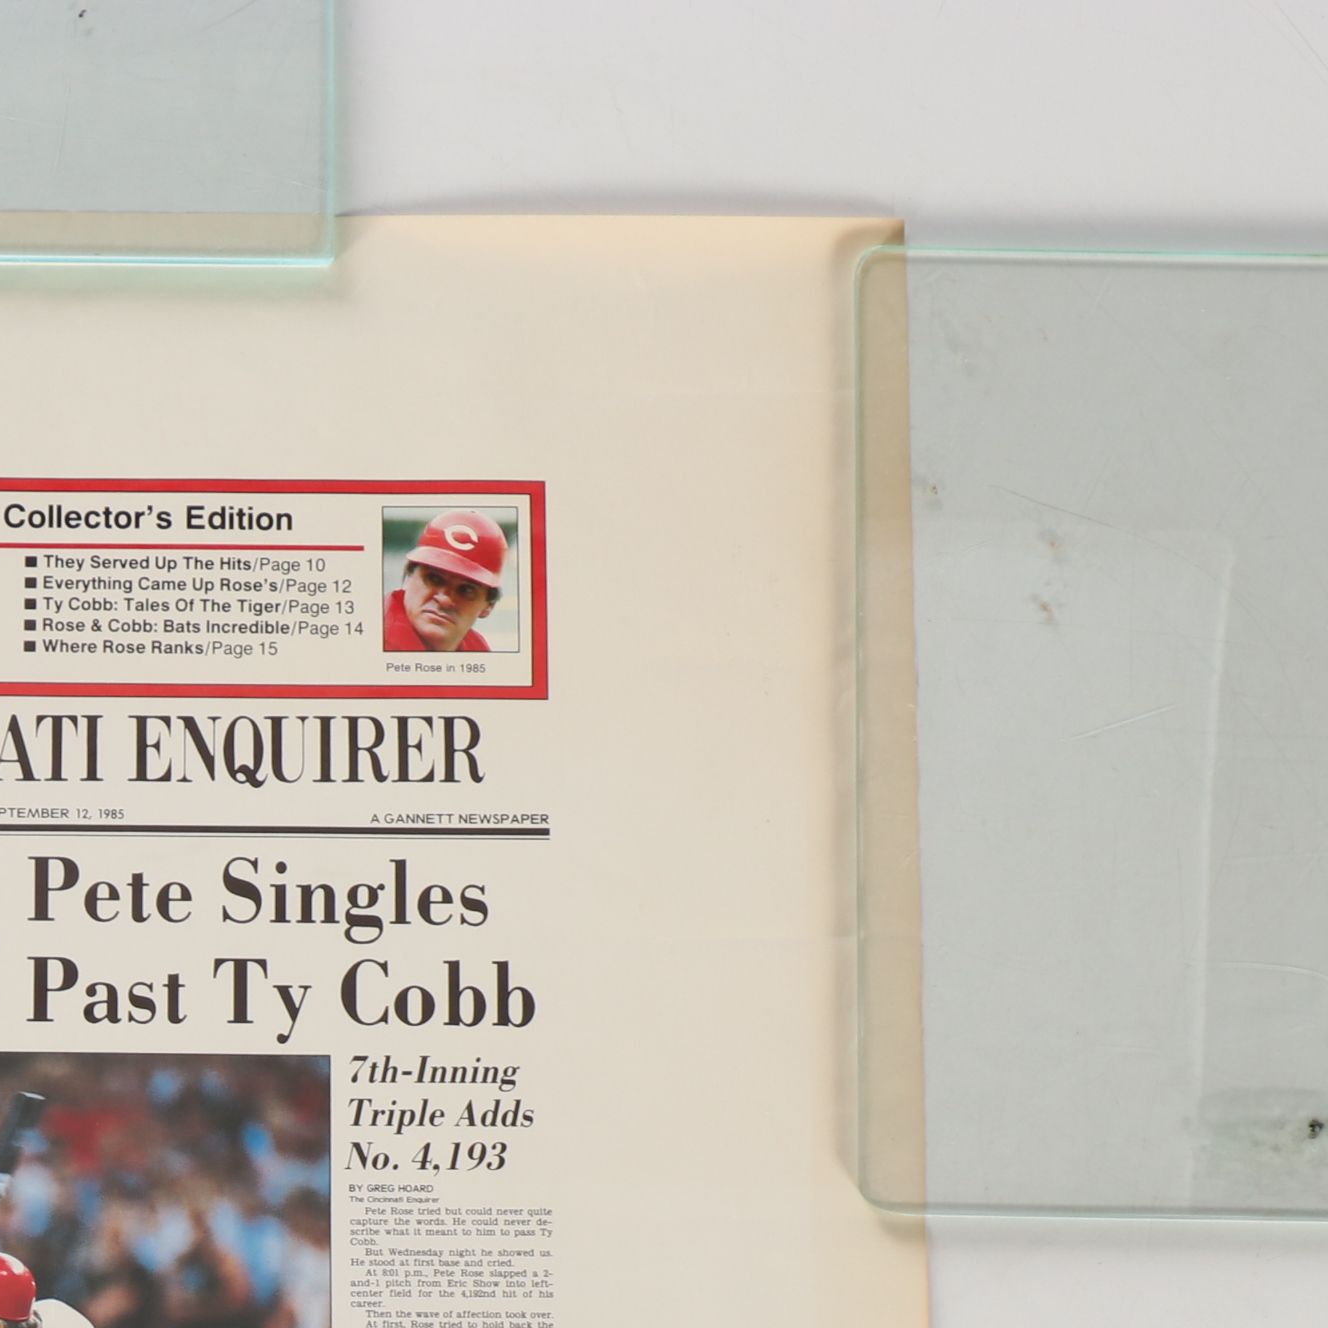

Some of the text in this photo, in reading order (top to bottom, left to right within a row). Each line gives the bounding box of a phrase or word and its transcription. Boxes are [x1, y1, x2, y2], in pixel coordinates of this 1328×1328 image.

[3, 503, 173, 530] Collector's
[186, 505, 293, 532] Edition
[42, 554, 326, 576] They Served Up The Hits/Page 10
[42, 575, 352, 597] Everything Came Up Rose's/Page 12
[42, 596, 355, 618] Ty Cobb: Tales Of The Tiger/Page 13
[42, 617, 364, 640] Rose & Cobb: Bats Incredible/Page 14
[42, 638, 279, 660] Where Rose Ranks/Page 15
[385, 662, 487, 674] Pete Rose in 1985
[127, 714, 485, 789] ENQUIRER
[75, 807, 93, 821] 12,
[97, 808, 125, 820] 1985
[369, 812, 550, 825] A GANNETT NEWSPAPER
[27, 855, 489, 945] Pete Singles
[25, 956, 536, 1045] Past Ty Cobb
[350, 1054, 521, 1093] 7th-Inning
[348, 1098, 535, 1136] Triple Adds
[344, 1141, 508, 1176] No. 4,193
[348, 1183, 434, 1194] BY GREG HOARD
